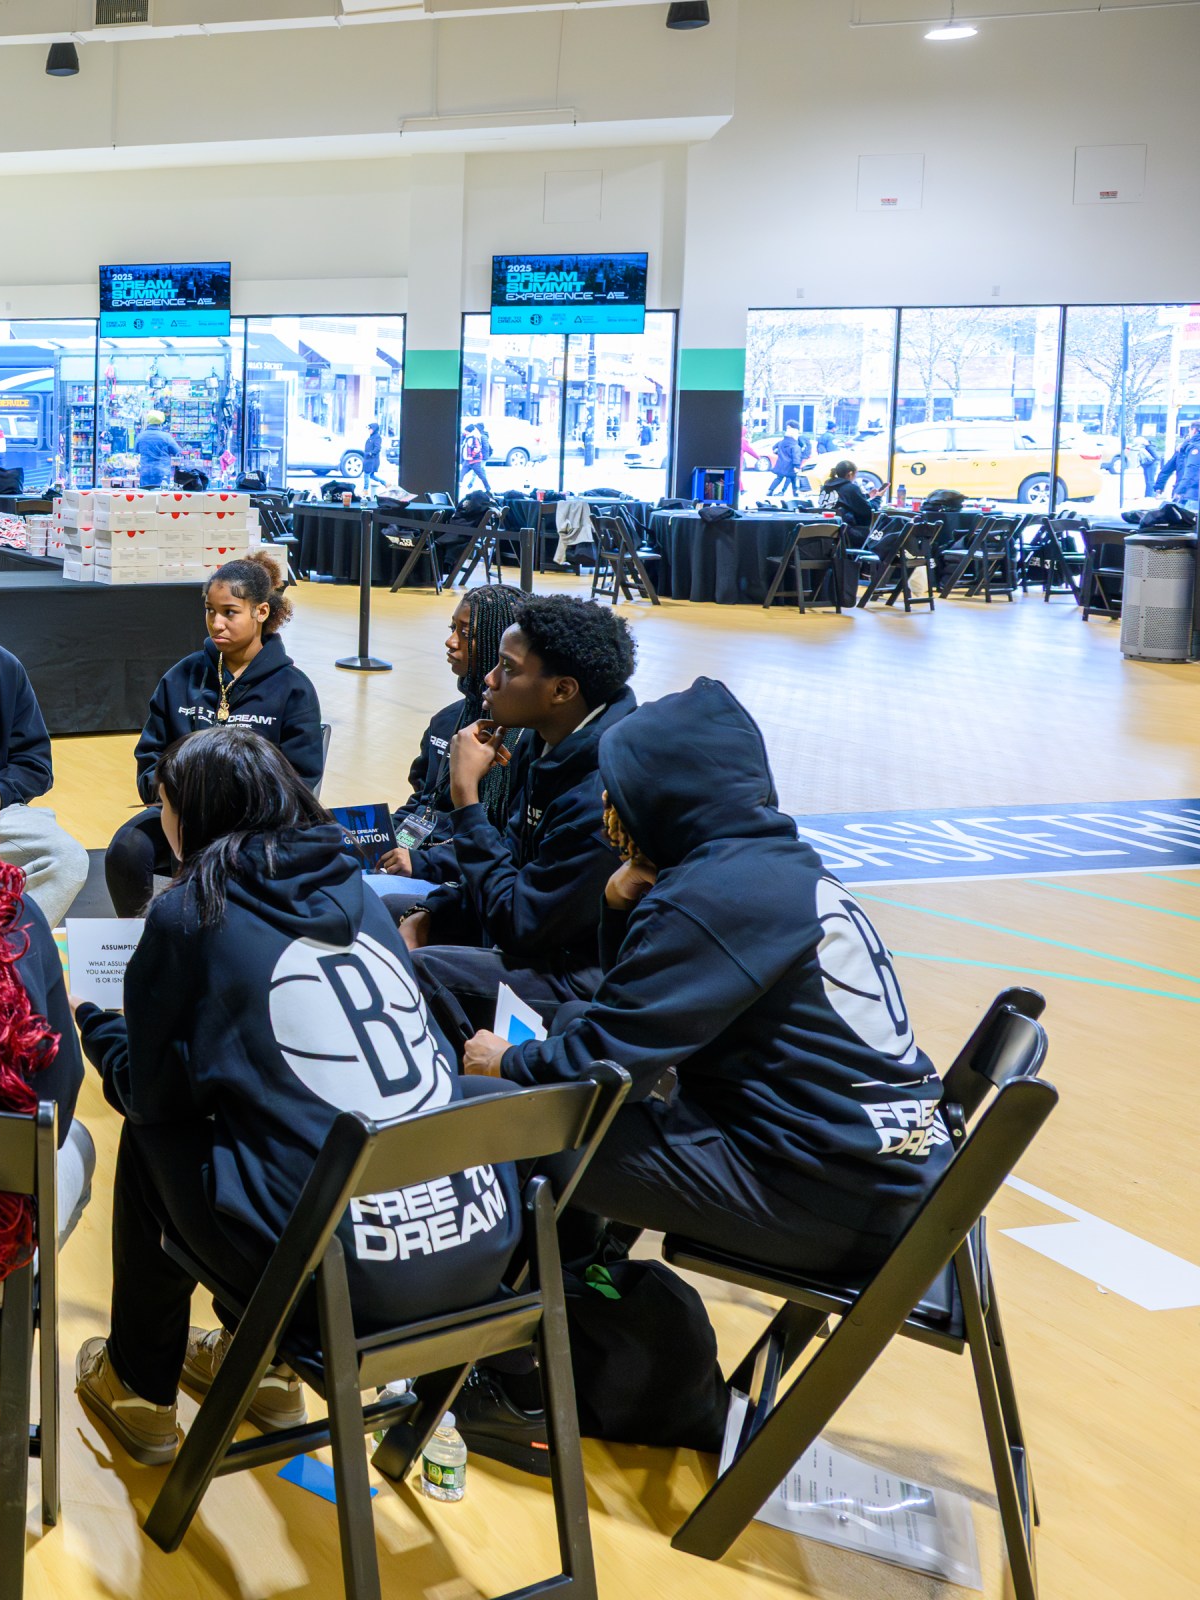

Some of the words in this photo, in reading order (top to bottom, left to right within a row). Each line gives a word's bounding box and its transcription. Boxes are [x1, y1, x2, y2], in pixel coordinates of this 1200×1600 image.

[507, 265, 532, 273] 2025
[506, 272, 578, 283] DREAM
[112, 280, 173, 290] DREAM
[506, 282, 586, 293] SUMMIT
[112, 289, 179, 300] SUMMIT
[505, 292, 594, 301] EXPERIENCE
[111, 298, 187, 307] EXPERIENCE
[227, 714, 272, 726] DREAM
[430, 735, 449, 750] REE
[860, 1099, 940, 1129] FRE
[350, 1175, 459, 1225] FREE
[463, 1163, 495, 1194] TO
[353, 1189, 507, 1262] DREAM
